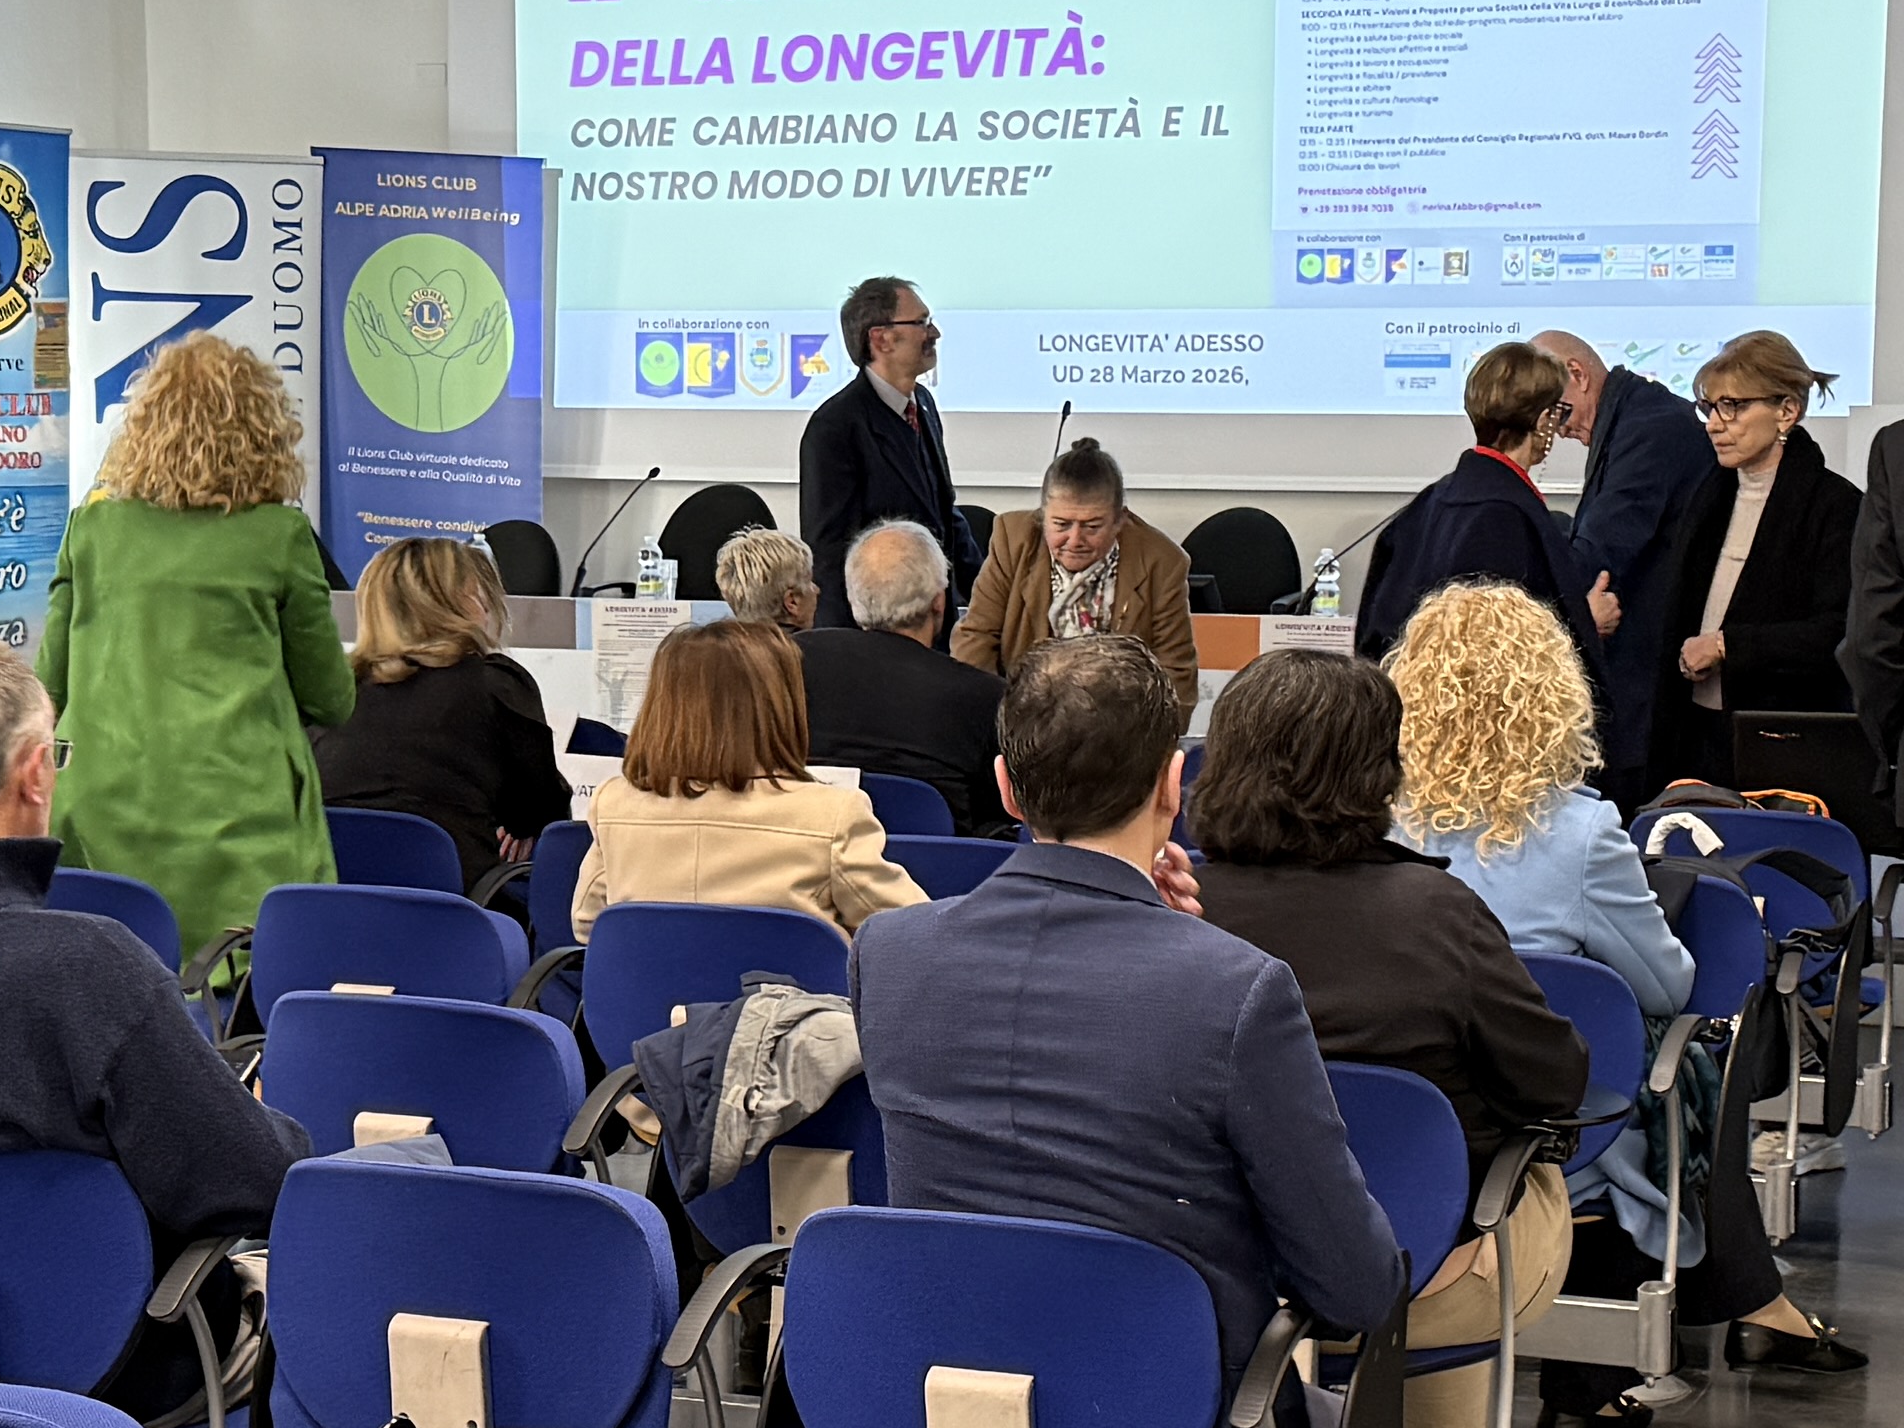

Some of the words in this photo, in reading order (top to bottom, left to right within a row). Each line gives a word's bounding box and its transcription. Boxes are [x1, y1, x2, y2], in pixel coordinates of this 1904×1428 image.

[570, 38, 735, 88] DELLA
[751, 10, 1106, 85] LONGEVITÀ:
[570, 117, 677, 148] COME
[693, 113, 897, 146] CAMBIANO
[915, 111, 958, 142] LA
[978, 96, 1141, 141] SOCIETÀ
[1161, 106, 1184, 137] E
[1200, 105, 1229, 136] IL
[377, 173, 427, 189] LIONS
[432, 175, 477, 191] CLUB
[570, 171, 719, 201] NOSTRO
[727, 168, 843, 200] MODO
[853, 168, 891, 198] DI
[335, 202, 375, 217] ALPE
[378, 204, 429, 219] ADRIA
[432, 206, 520, 226] WellBeing
[272, 178, 304, 374] DUOMO
[423, 304, 435, 324] L
[638, 318, 649, 329] In
[653, 318, 743, 330] collaborazione
[747, 320, 769, 329] con
[1385, 322, 1413, 334] Con
[1417, 322, 1424, 334] il
[1429, 322, 1502, 336] patrocinio
[1508, 322, 1520, 334] di
[1039, 333, 1168, 353] LONGEVITA'
[1174, 334, 1264, 352] ADESSO
[1052, 365, 1083, 383] UD
[1090, 366, 1114, 383] 28
[1121, 365, 1185, 383] Marzo
[1191, 366, 1249, 386] 2026,
[357, 448, 386, 459] Lions
[388, 449, 413, 460] Club
[416, 452, 457, 464] virtuale
[460, 455, 509, 469] dedicato
[338, 462, 349, 472] al
[352, 463, 408, 477] Benessere
[418, 469, 440, 480] alla
[442, 470, 482, 483] Qualità
[486, 474, 496, 484] di
[499, 476, 521, 486] Vita
